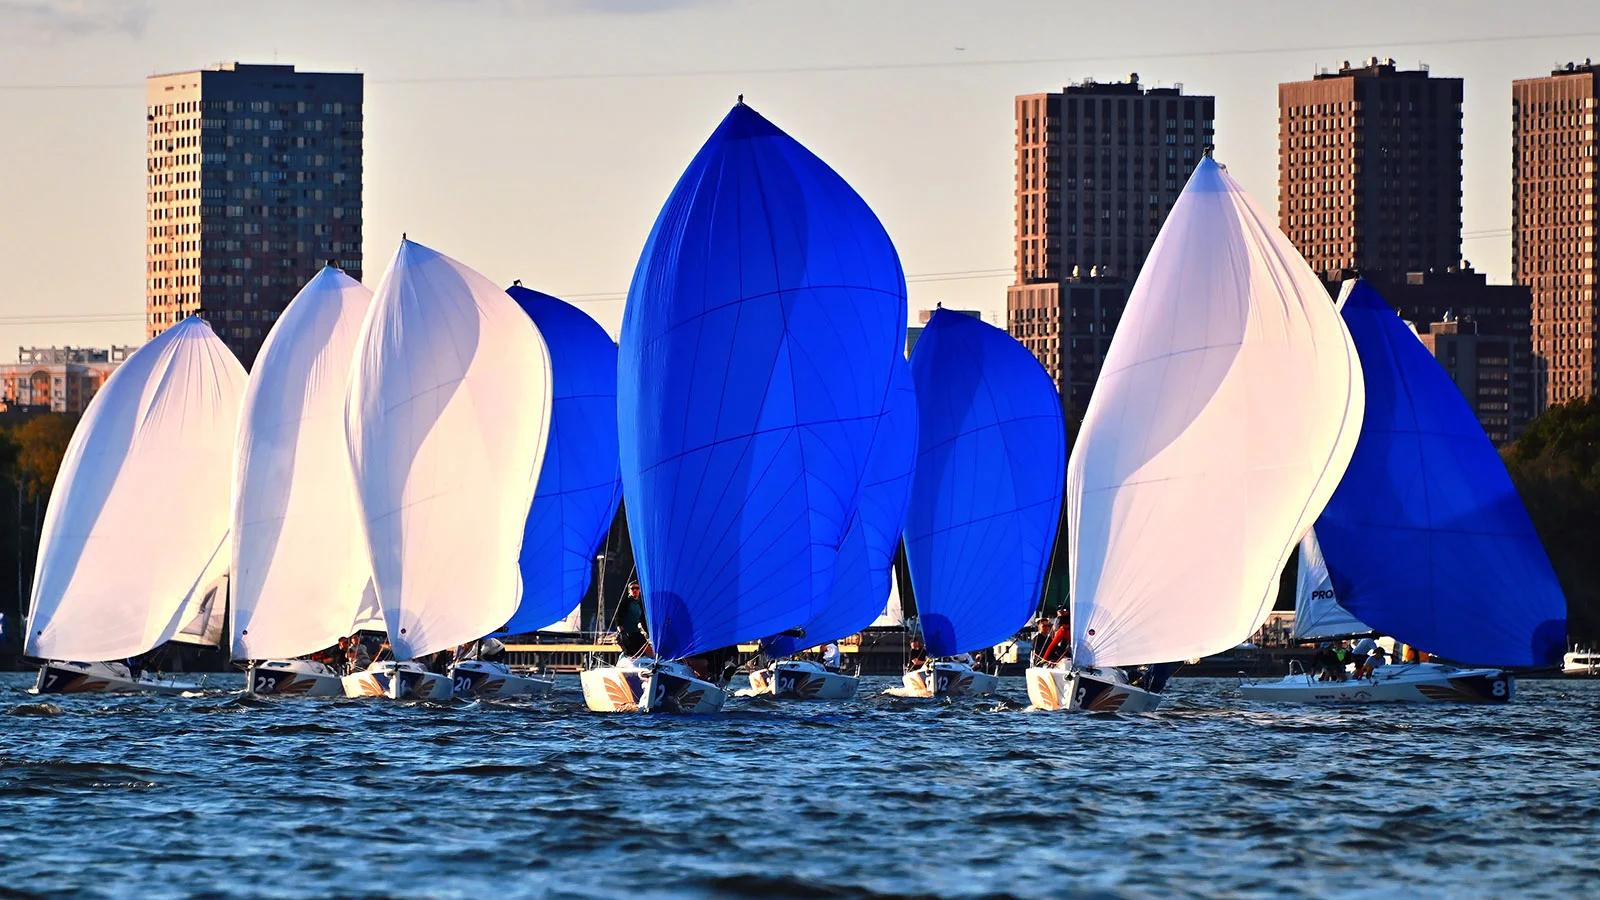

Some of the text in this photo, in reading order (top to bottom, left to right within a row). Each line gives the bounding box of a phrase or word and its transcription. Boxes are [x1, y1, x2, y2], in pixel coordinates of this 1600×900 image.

[1312, 589, 1334, 600] PRO
[46, 675, 57, 688] 7
[257, 676, 275, 690] 23
[454, 676, 471, 692] 20
[781, 677, 795, 690] 24
[937, 676, 949, 691] 12
[1492, 680, 1506, 696] 8
[654, 684, 665, 706] 2
[1077, 687, 1086, 705] 3
